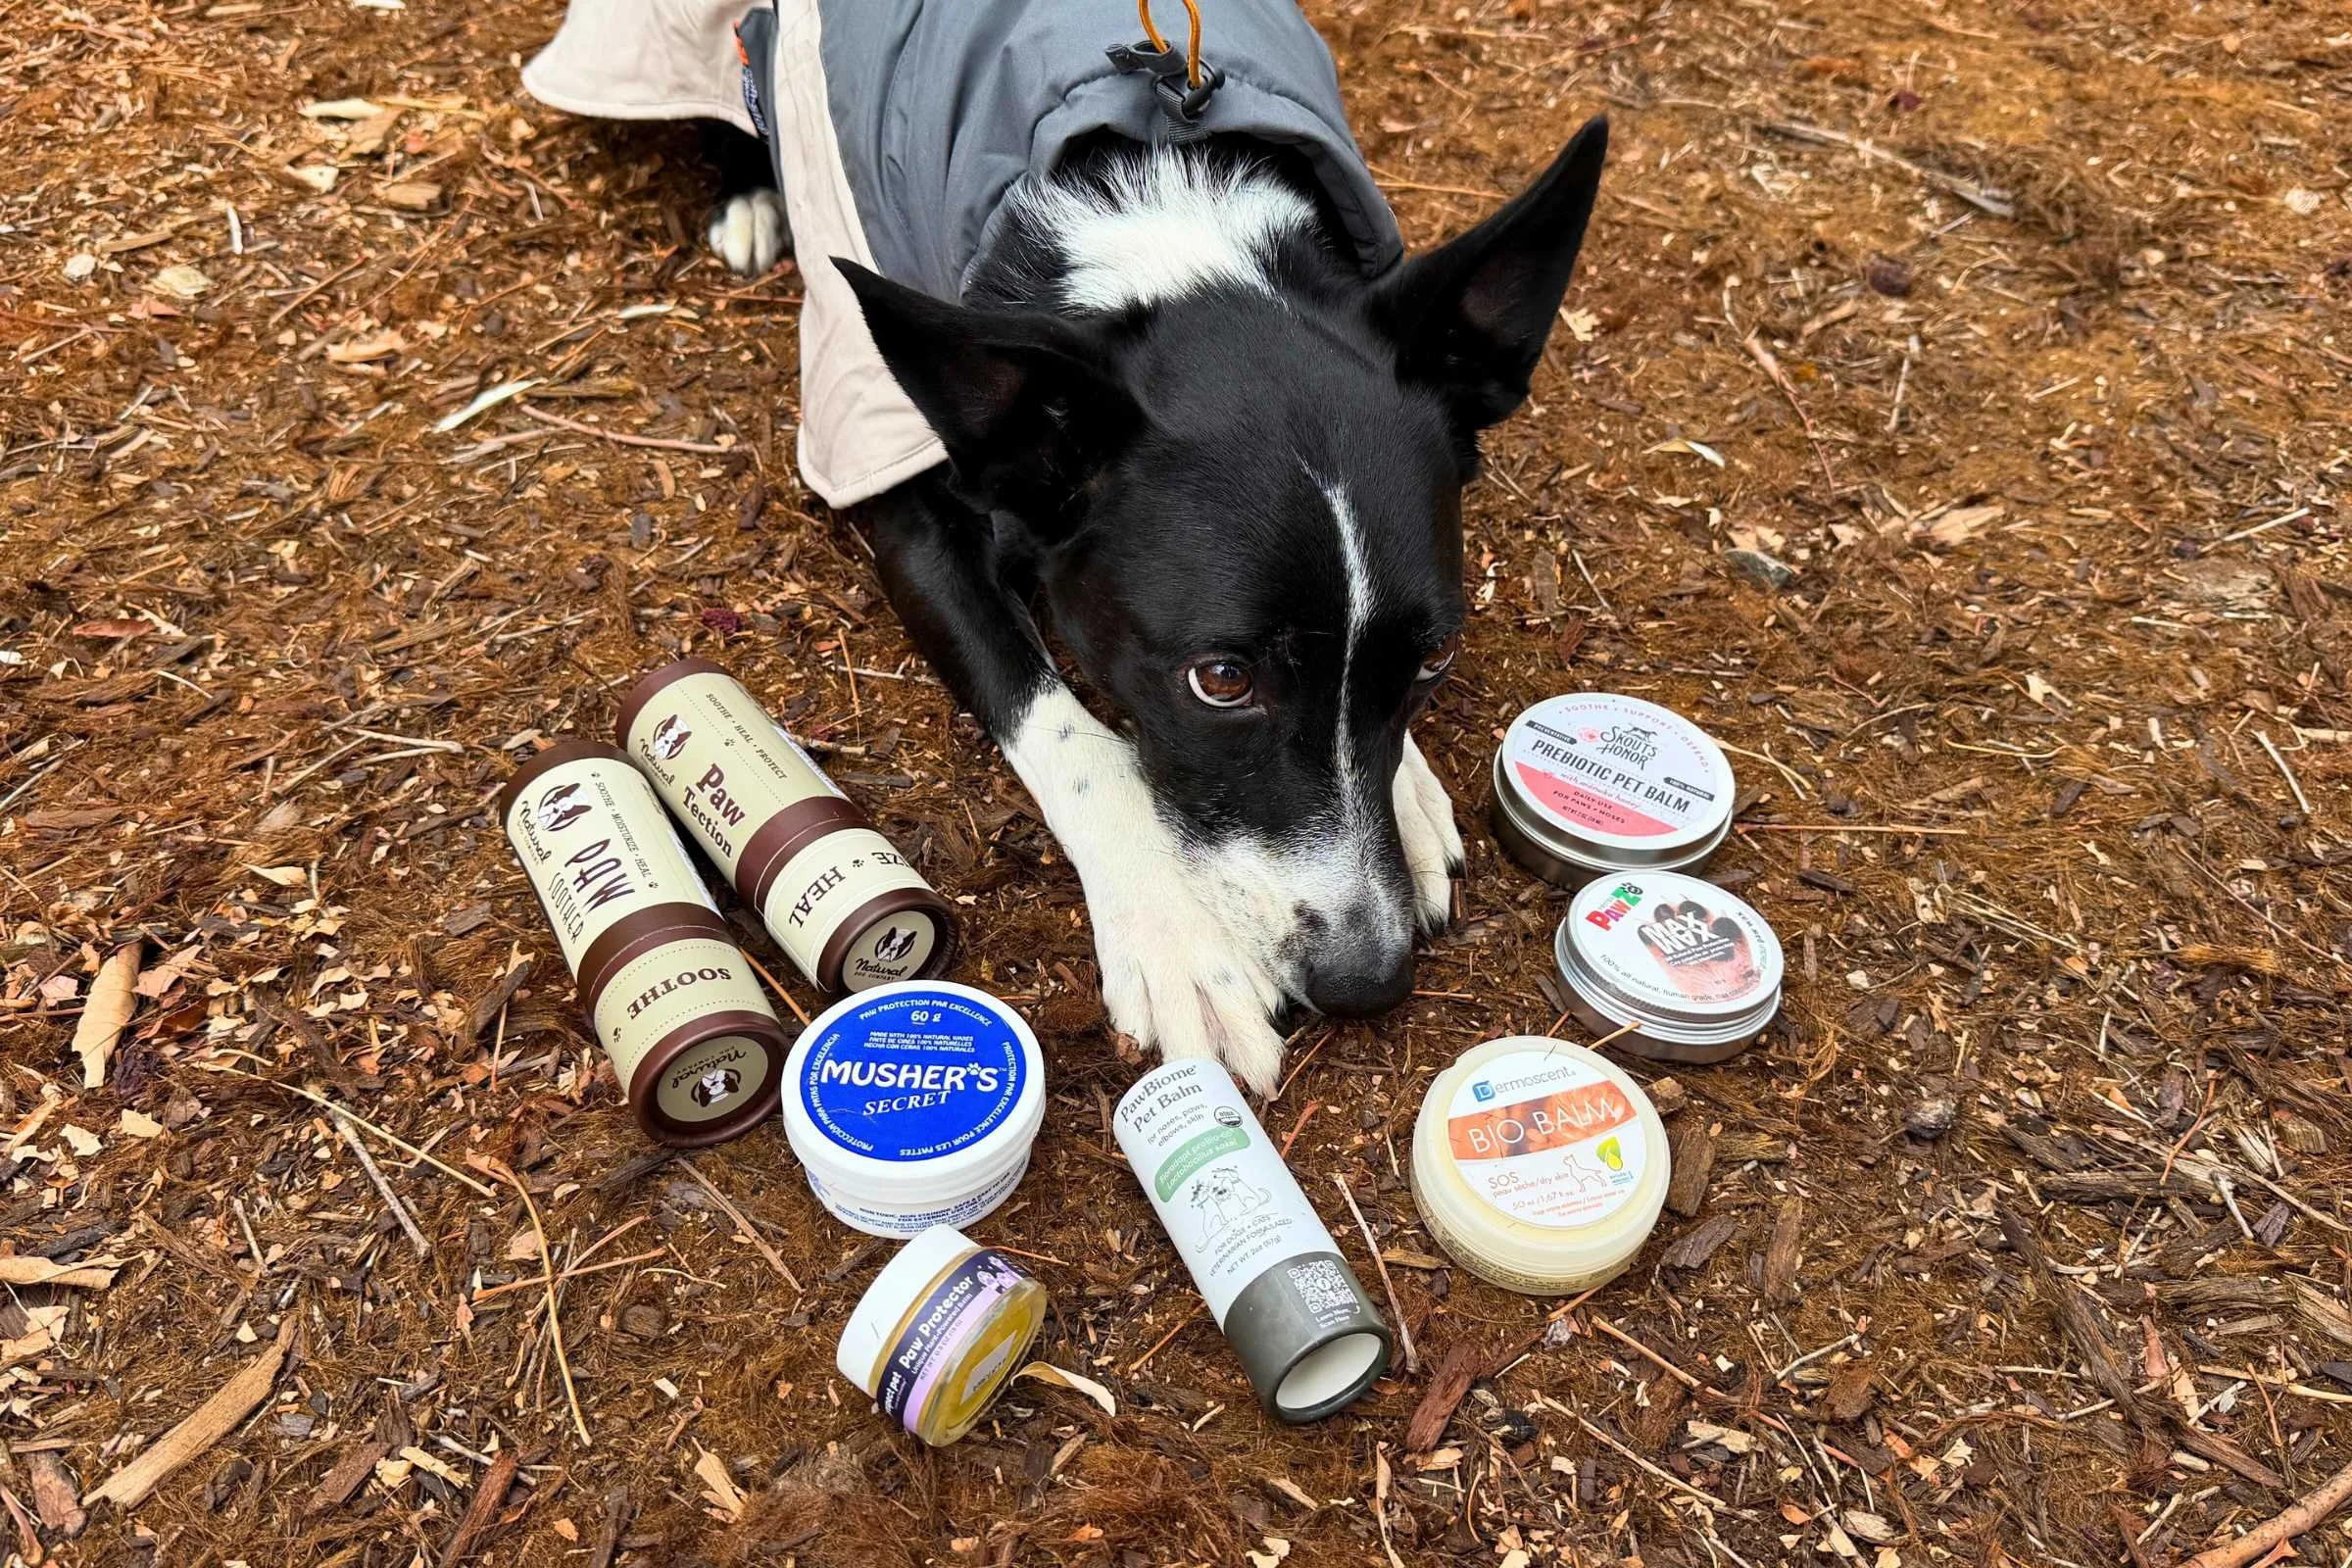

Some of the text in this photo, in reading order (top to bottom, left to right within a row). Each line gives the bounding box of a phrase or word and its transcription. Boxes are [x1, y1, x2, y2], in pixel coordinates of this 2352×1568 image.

[706, 693, 788, 780] SOOTHE HEAL PROTECT
[1624, 708, 1672, 729] SUPPORT
[640, 738, 675, 786] Natural
[1595, 744, 1648, 770] HONOR
[1599, 726, 1657, 758] SKOUTS
[696, 762, 746, 827] Paw
[1532, 740, 1690, 812] PREBIOTIC PET BALM
[520, 801, 553, 865] Natural
[595, 782, 653, 878] SOOTHE MOISTURIZE HEAL
[683, 784, 733, 858] Tection
[564, 838, 636, 915] PAW
[788, 865, 846, 929] HEAL
[548, 871, 585, 944] SOOTHER
[856, 957, 908, 977] Natural
[626, 967, 732, 1020] SOOTHE
[858, 999, 993, 1027] PAW PROTECTION PAR EXCELLENCE
[910, 1010, 942, 1022] 60 g
[672, 1050, 748, 1090] Natural
[1002, 1041, 1017, 1082] PROTECTION
[862, 1090, 952, 1115] SECRET
[974, 1097, 1011, 1134] EXCELLENCE
[1133, 1082, 1203, 1133] Pet Balm
[1148, 1102, 1208, 1145] for noses, paws,
[953, 1132, 977, 1147] POUR
[1158, 1122, 1188, 1147] elbows,
[1187, 1113, 1204, 1126] skin
[1468, 1097, 1619, 1153] BIO BALM
[1488, 1171, 1519, 1190] SOS
[1214, 1241, 1228, 1255] FOR
[1227, 1227, 1247, 1246] DOGS
[1226, 1260, 1241, 1276] NET
[899, 1338, 925, 1370] Paw
[918, 1275, 974, 1338] Protector
